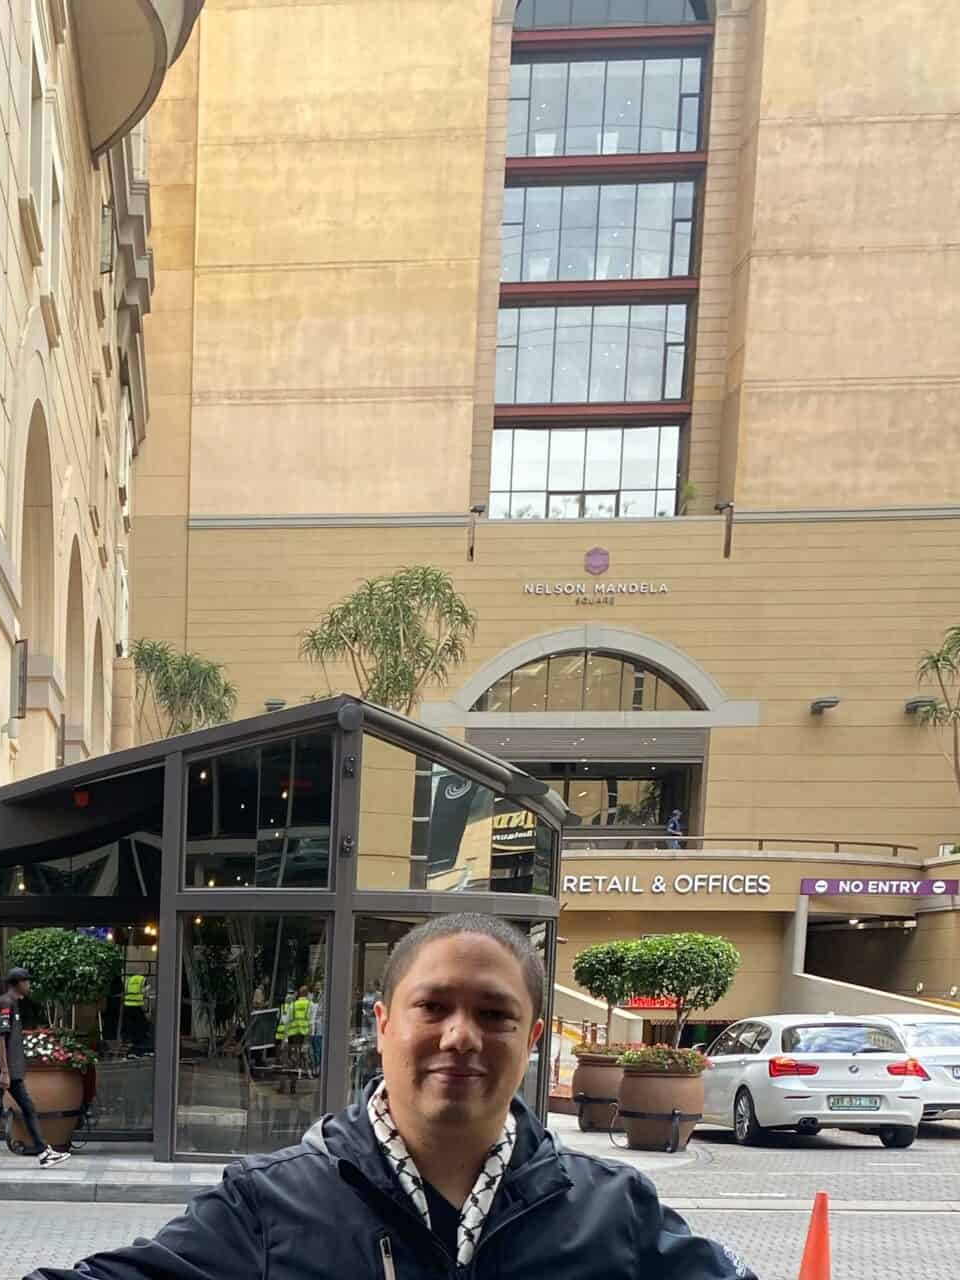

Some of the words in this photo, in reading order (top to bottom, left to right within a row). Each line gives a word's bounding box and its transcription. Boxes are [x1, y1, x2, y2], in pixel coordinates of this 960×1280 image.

[524, 583, 586, 595] NELSON
[594, 583, 669, 594] MANDELA
[563, 876, 644, 893] RETAIL
[652, 877, 667, 892] &
[675, 875, 771, 894] OFFICES
[839, 880, 863, 894] NO
[868, 880, 921, 894] ENTRY
